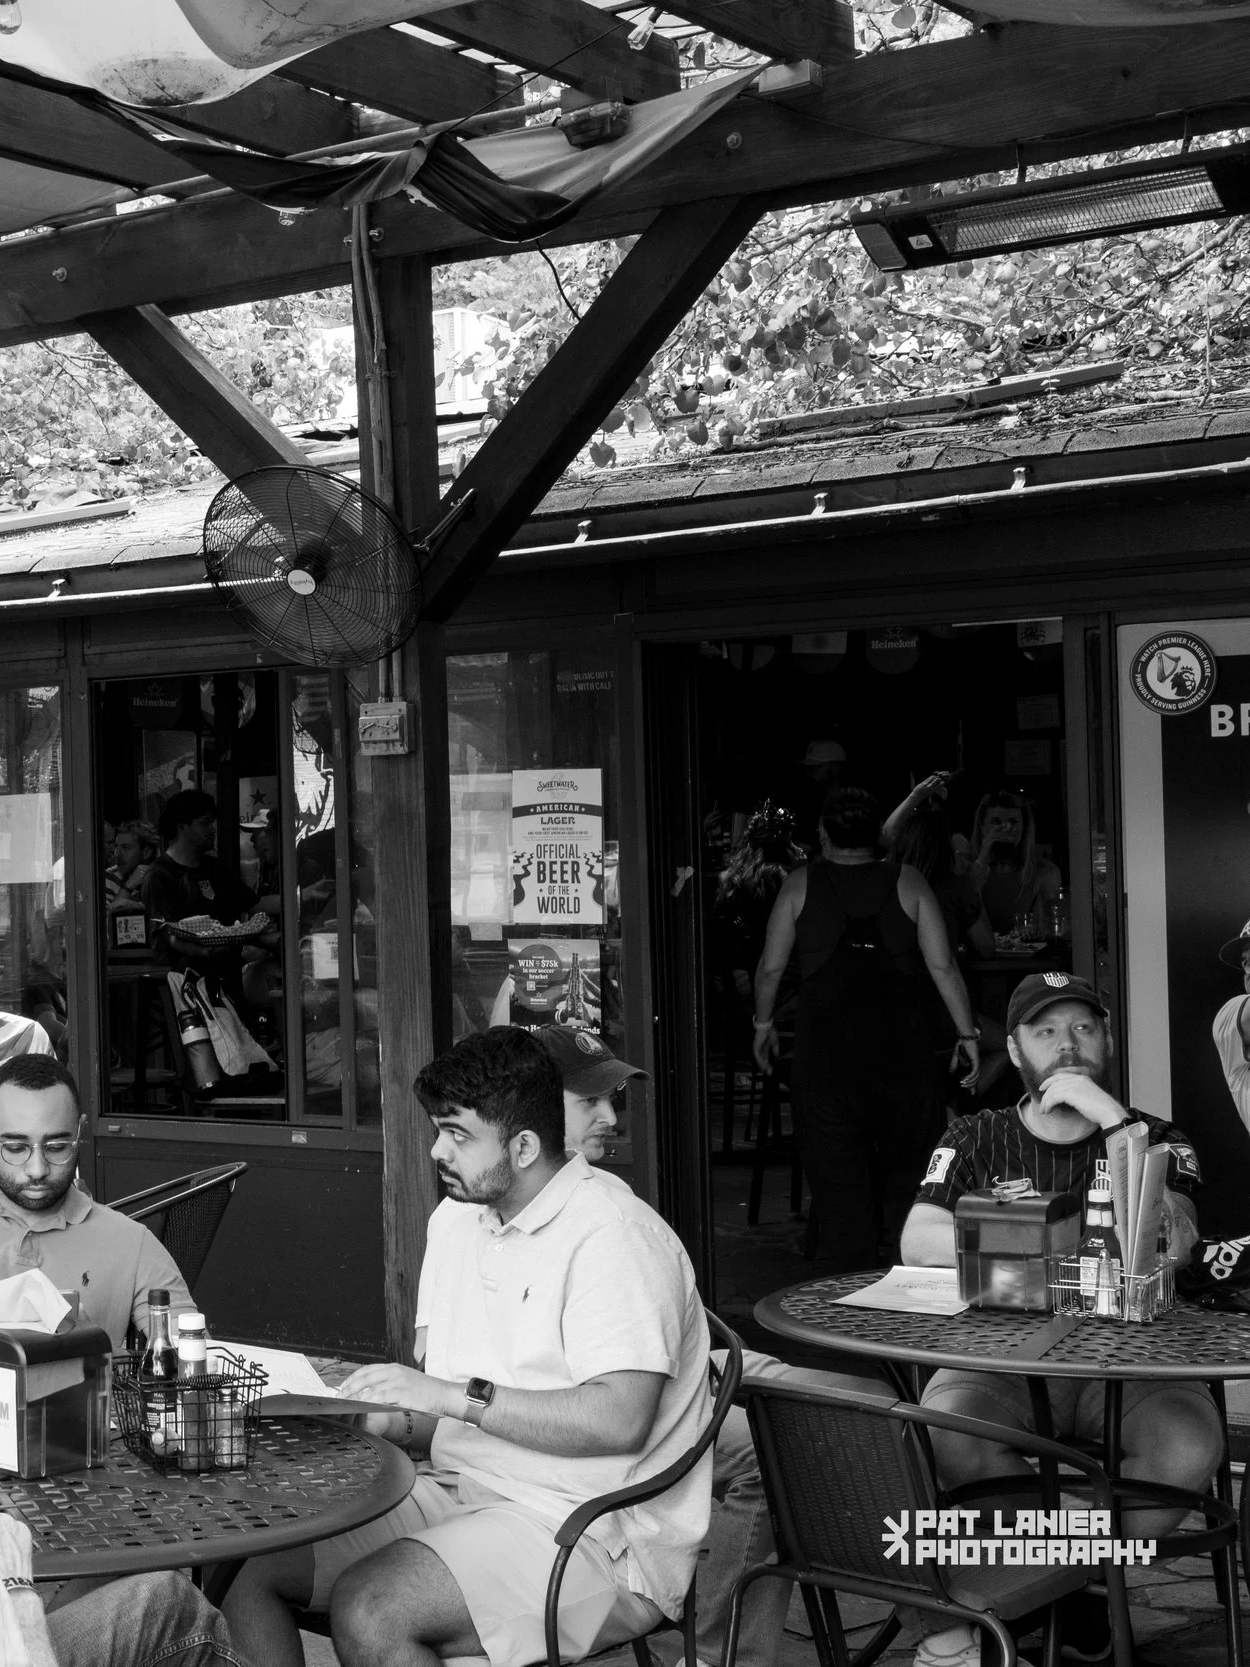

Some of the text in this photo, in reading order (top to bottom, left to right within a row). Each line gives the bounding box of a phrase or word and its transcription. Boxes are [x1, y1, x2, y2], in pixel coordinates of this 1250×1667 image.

[870, 639, 917, 650] Heineken
[1140, 637, 1211, 677] WATCH PREMIER LEAGUE HERE
[1135, 673, 1208, 710] PROUDLY SERVING GUINNESS
[132, 696, 177, 708] Heineken
[536, 803, 580, 813] AMERICAN
[540, 816, 576, 825] LAGER
[536, 843, 581, 859] OFFICIAL
[537, 860, 581, 884] BEER
[547, 885, 570, 895] OF THE
[537, 896, 581, 914] WORLD
[518, 959, 535, 968] WIN
